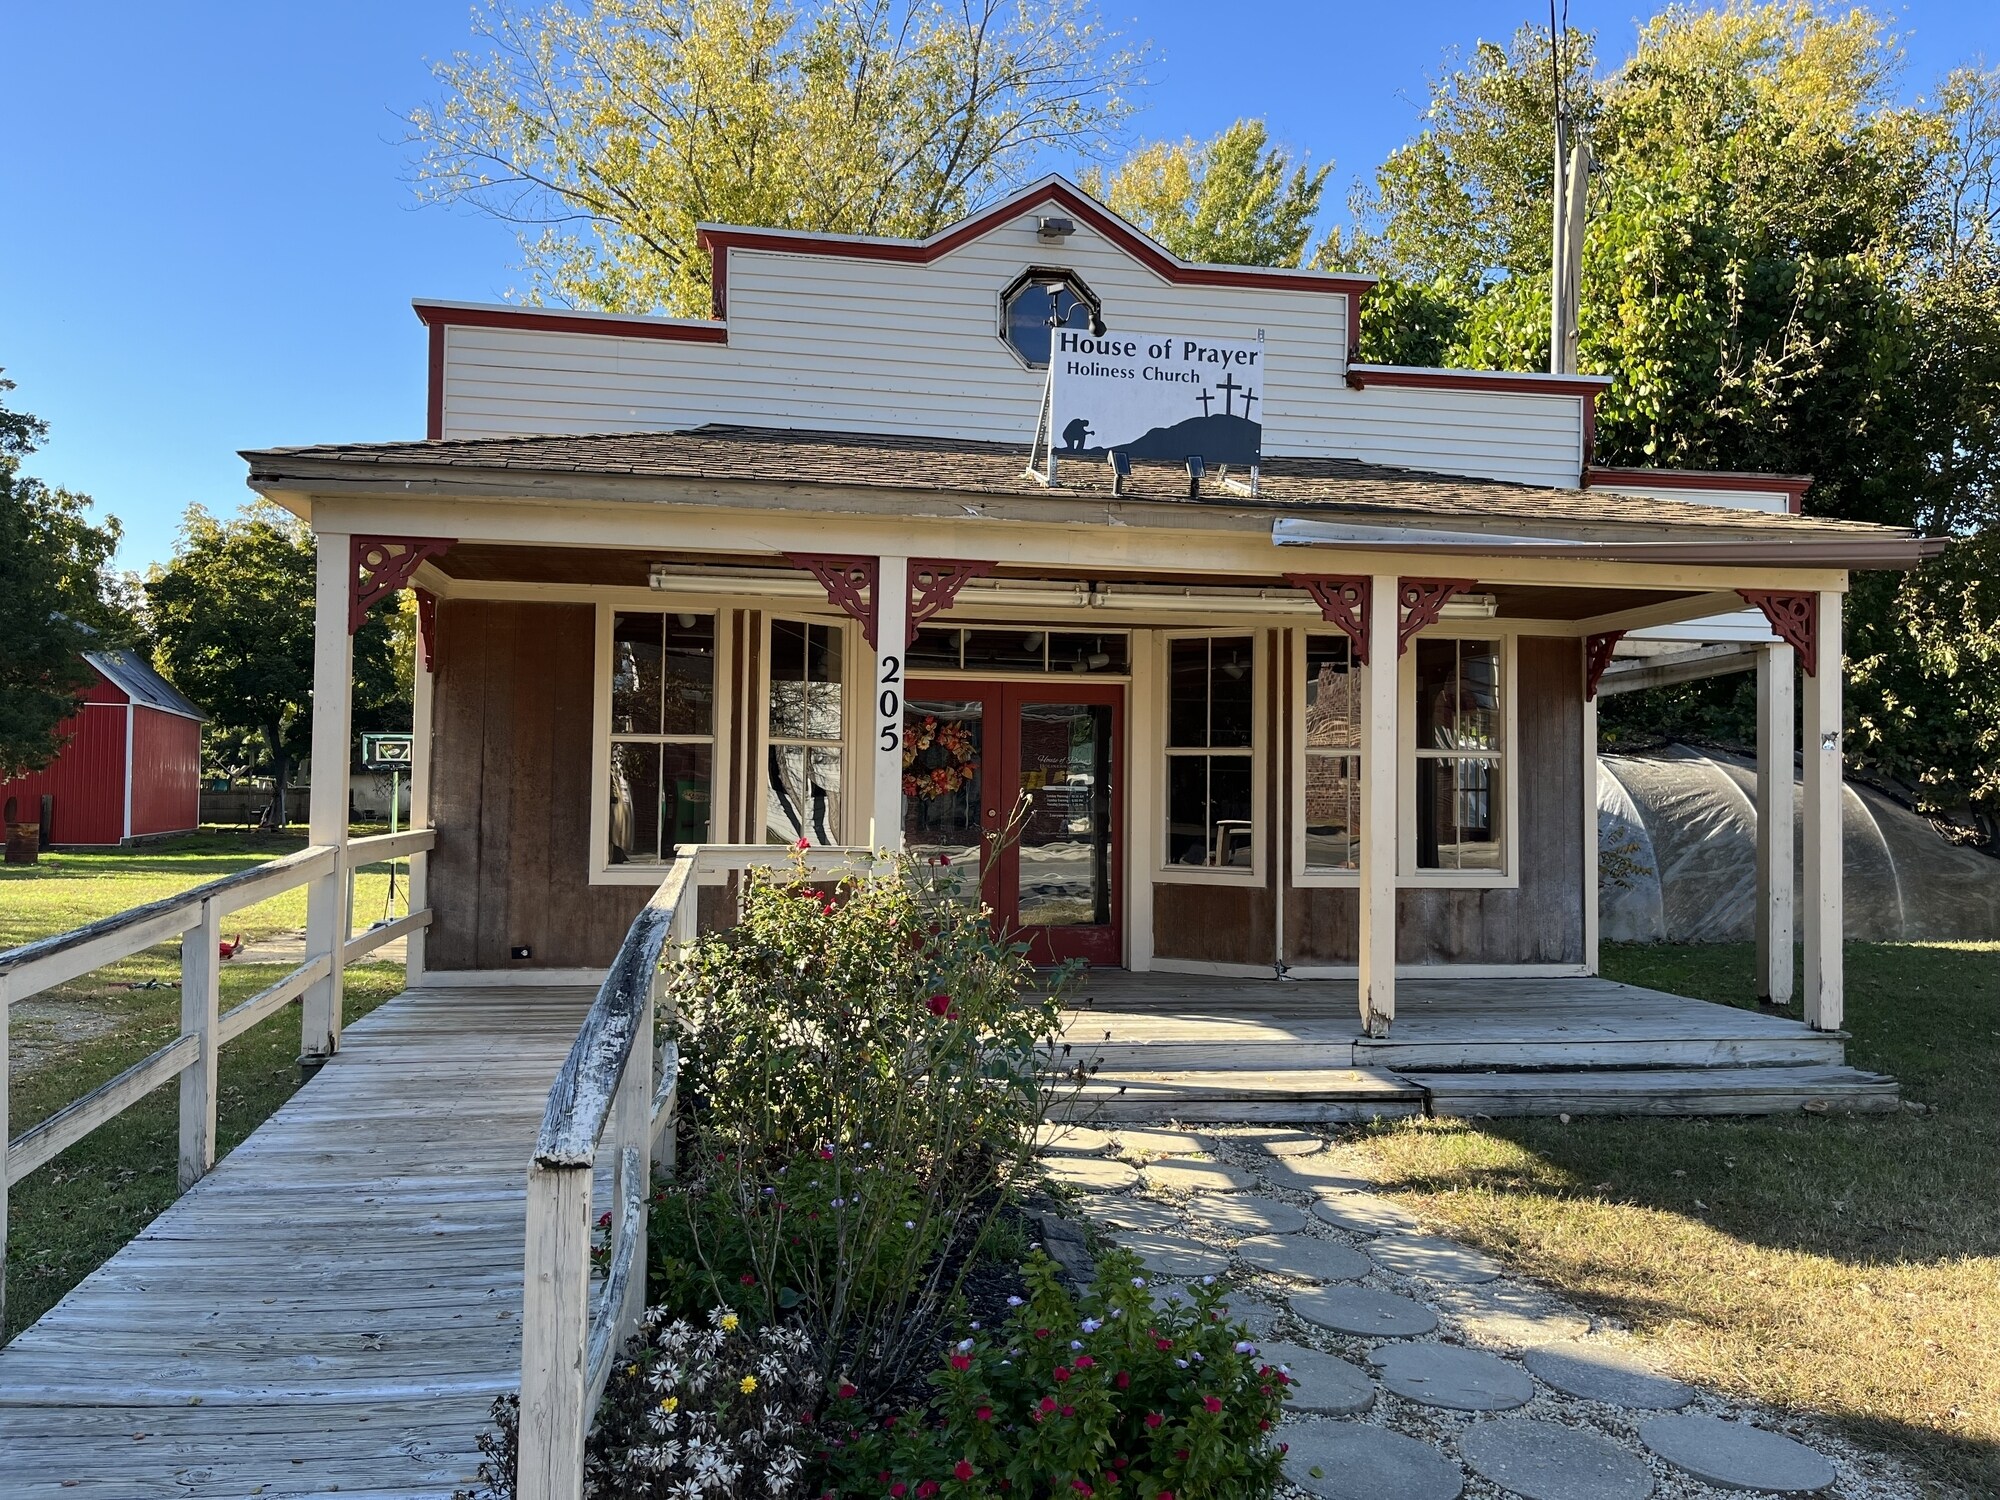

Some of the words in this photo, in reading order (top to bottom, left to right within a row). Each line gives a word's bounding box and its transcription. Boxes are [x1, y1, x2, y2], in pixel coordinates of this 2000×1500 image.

[1060, 332, 1136, 357] House
[1148, 339, 1172, 359] of
[1183, 341, 1258, 370] Prayer
[1067, 361, 1135, 379] Holiness
[1142, 366, 1200, 383] Church
[880, 655, 900, 752] 205
